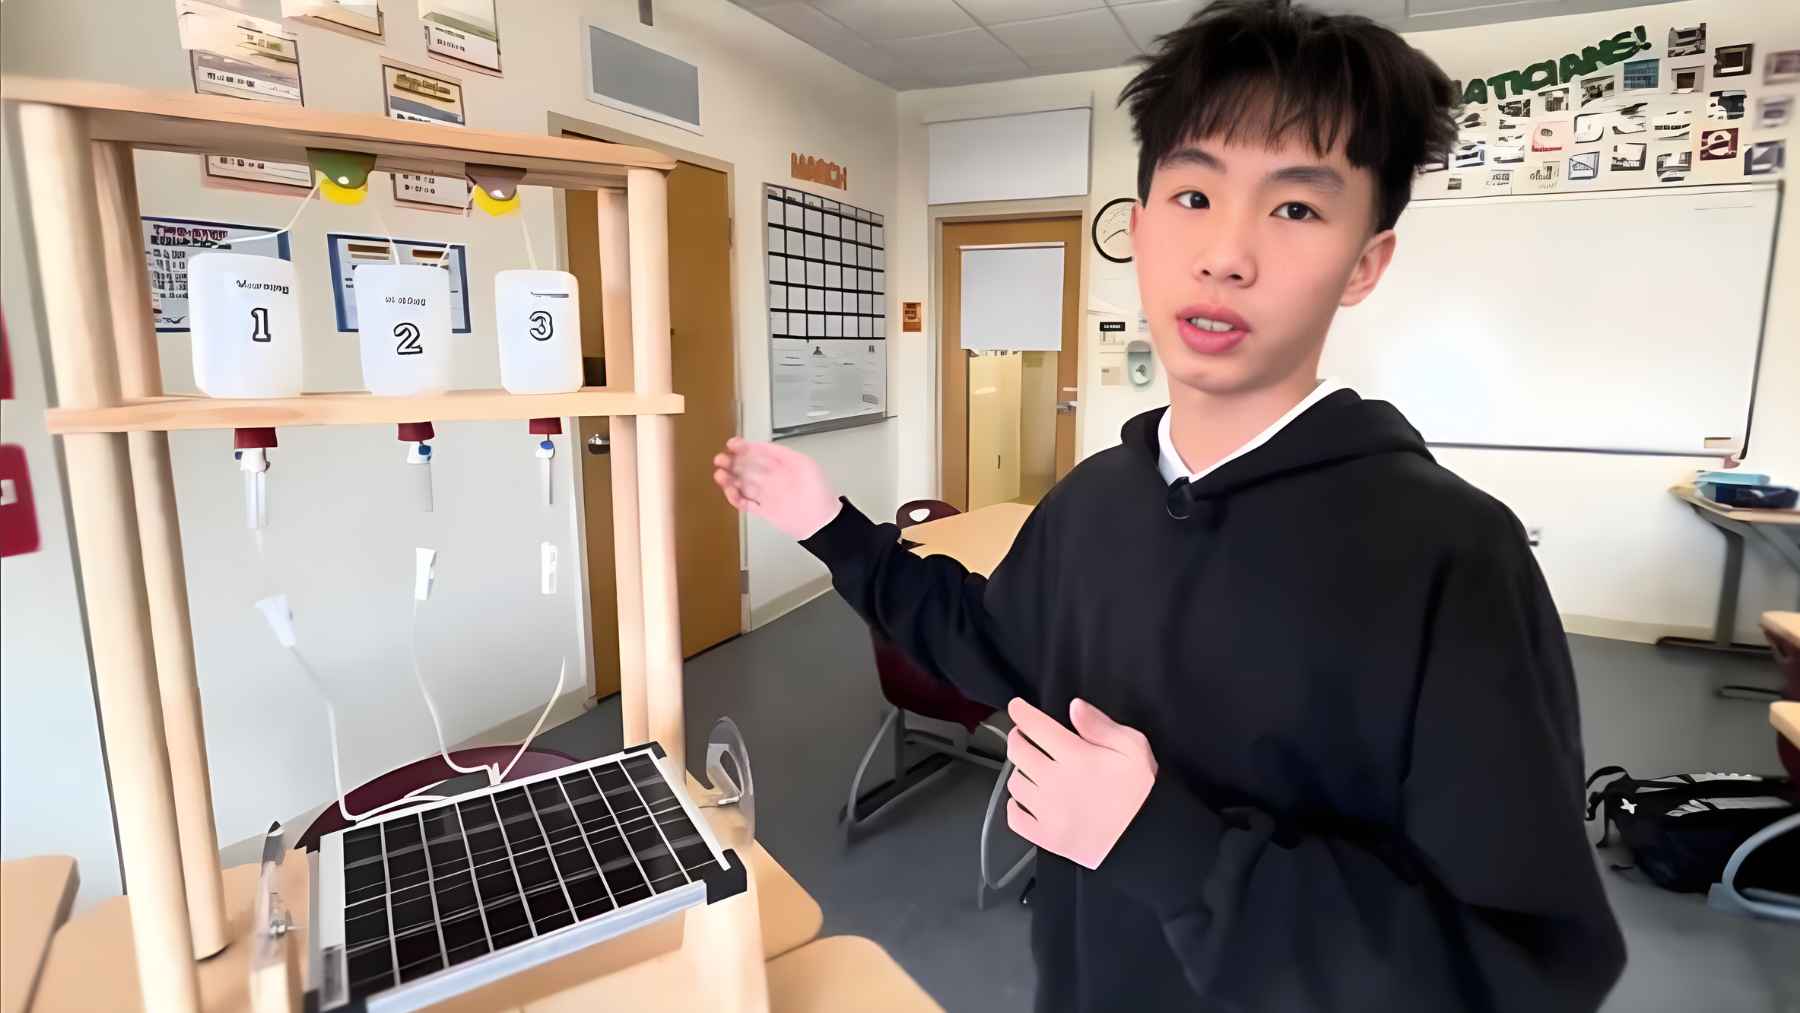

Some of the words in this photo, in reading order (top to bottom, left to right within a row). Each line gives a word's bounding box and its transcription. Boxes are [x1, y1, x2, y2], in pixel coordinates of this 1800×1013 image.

[251, 307, 271, 342] 1
[393, 322, 423, 355] 2
[529, 310, 553, 341] 3
